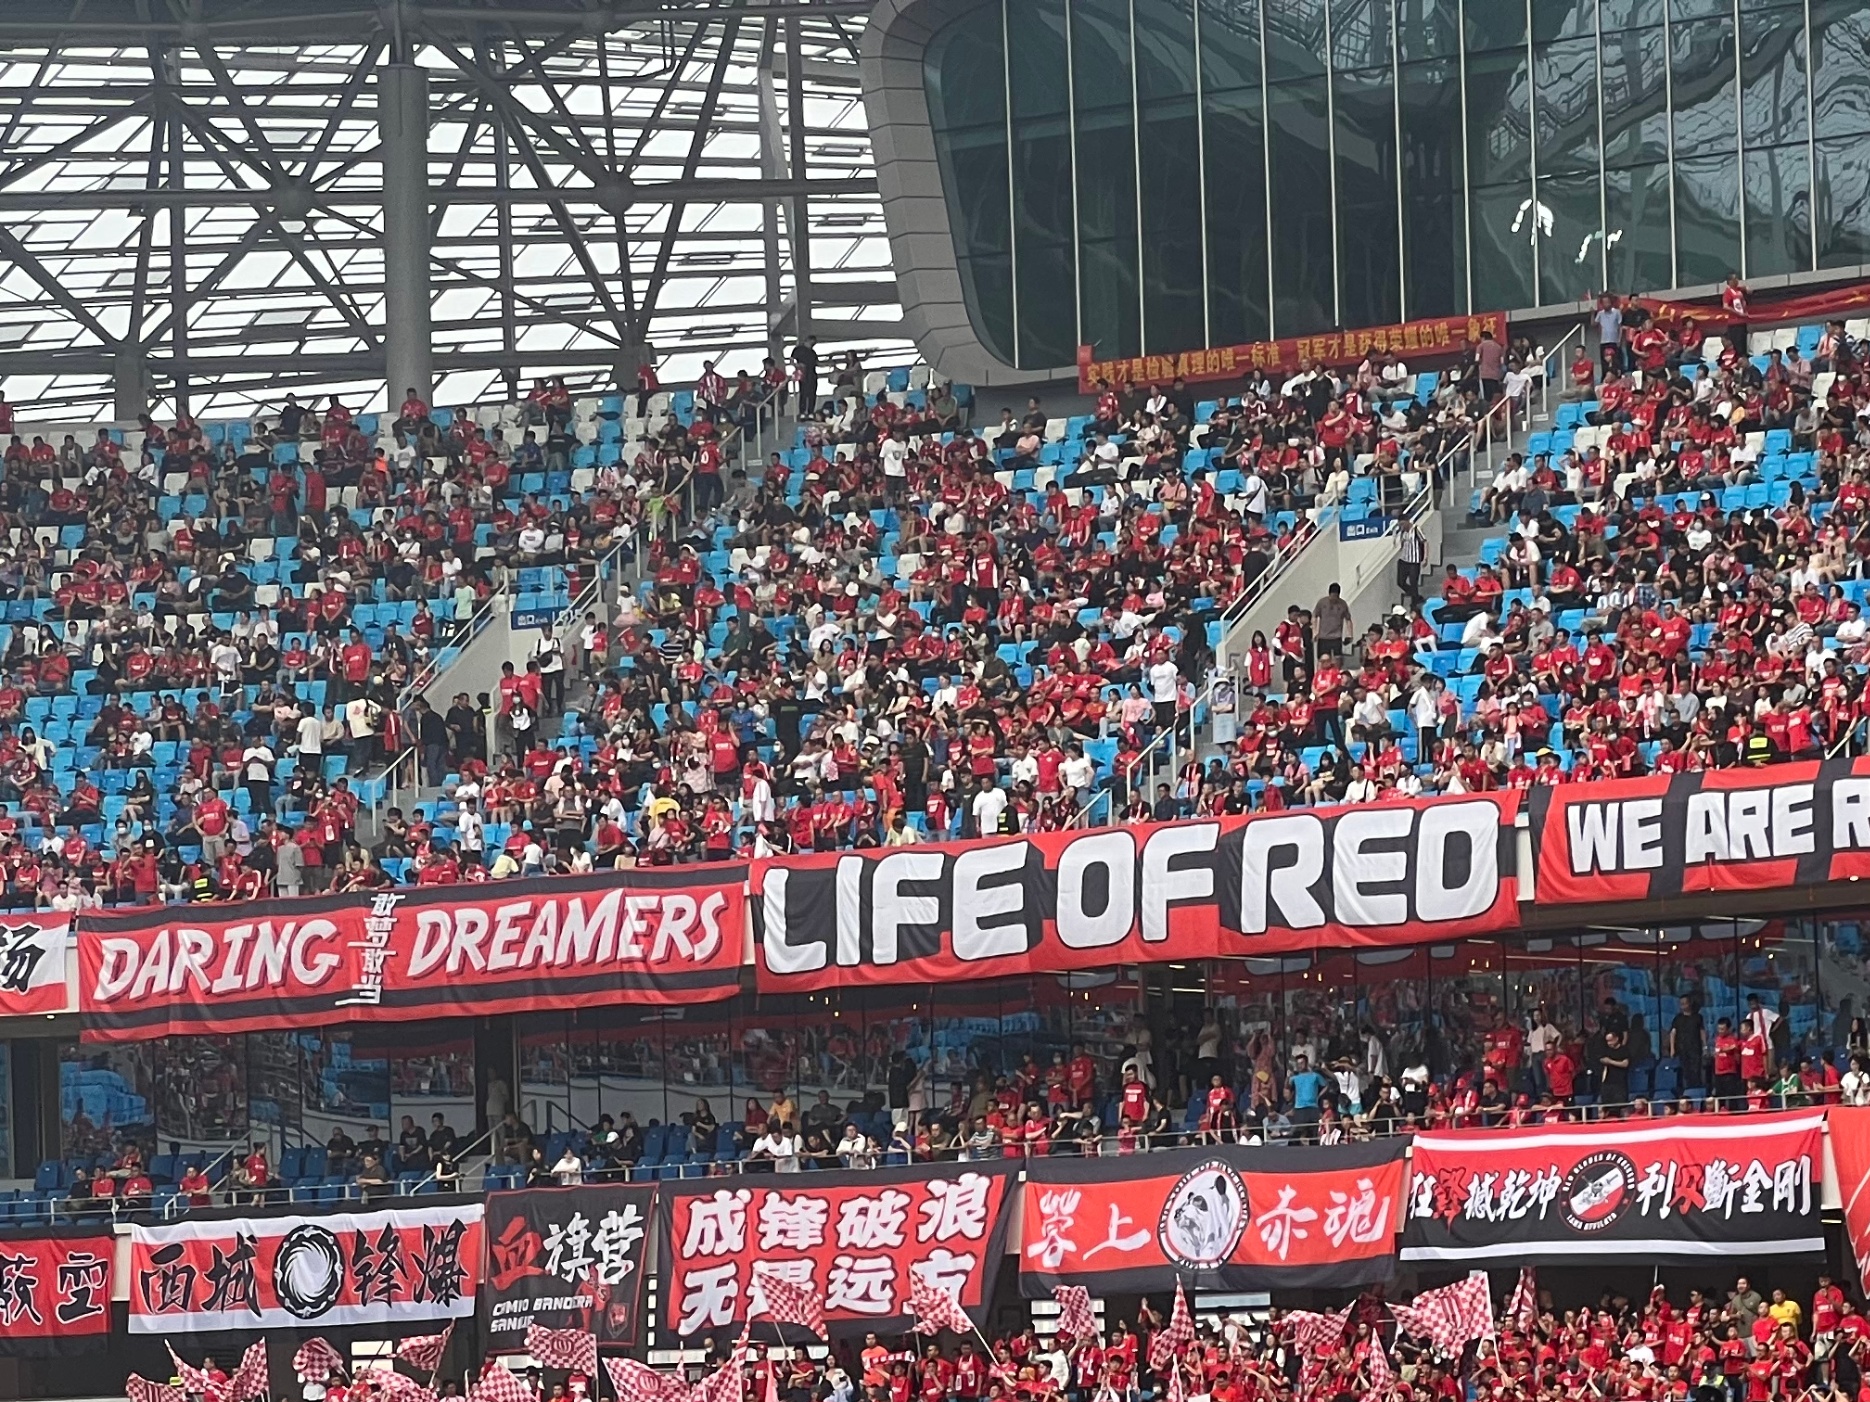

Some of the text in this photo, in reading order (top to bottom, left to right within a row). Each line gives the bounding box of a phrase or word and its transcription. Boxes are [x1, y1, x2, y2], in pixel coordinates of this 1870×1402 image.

[1347, 524, 1365, 536] 出口
[518, 614, 534, 626] 出口
[1567, 799, 1663, 874] WE
[1685, 782, 1816, 864] ARE
[762, 799, 1500, 975] LIFE OF RED
[93, 886, 728, 1001] DARING DREAMERS
[491, 1203, 645, 1292] 血旗营
[683, 1172, 987, 1258] 成锋破浪
[141, 1231, 263, 1318] 西城
